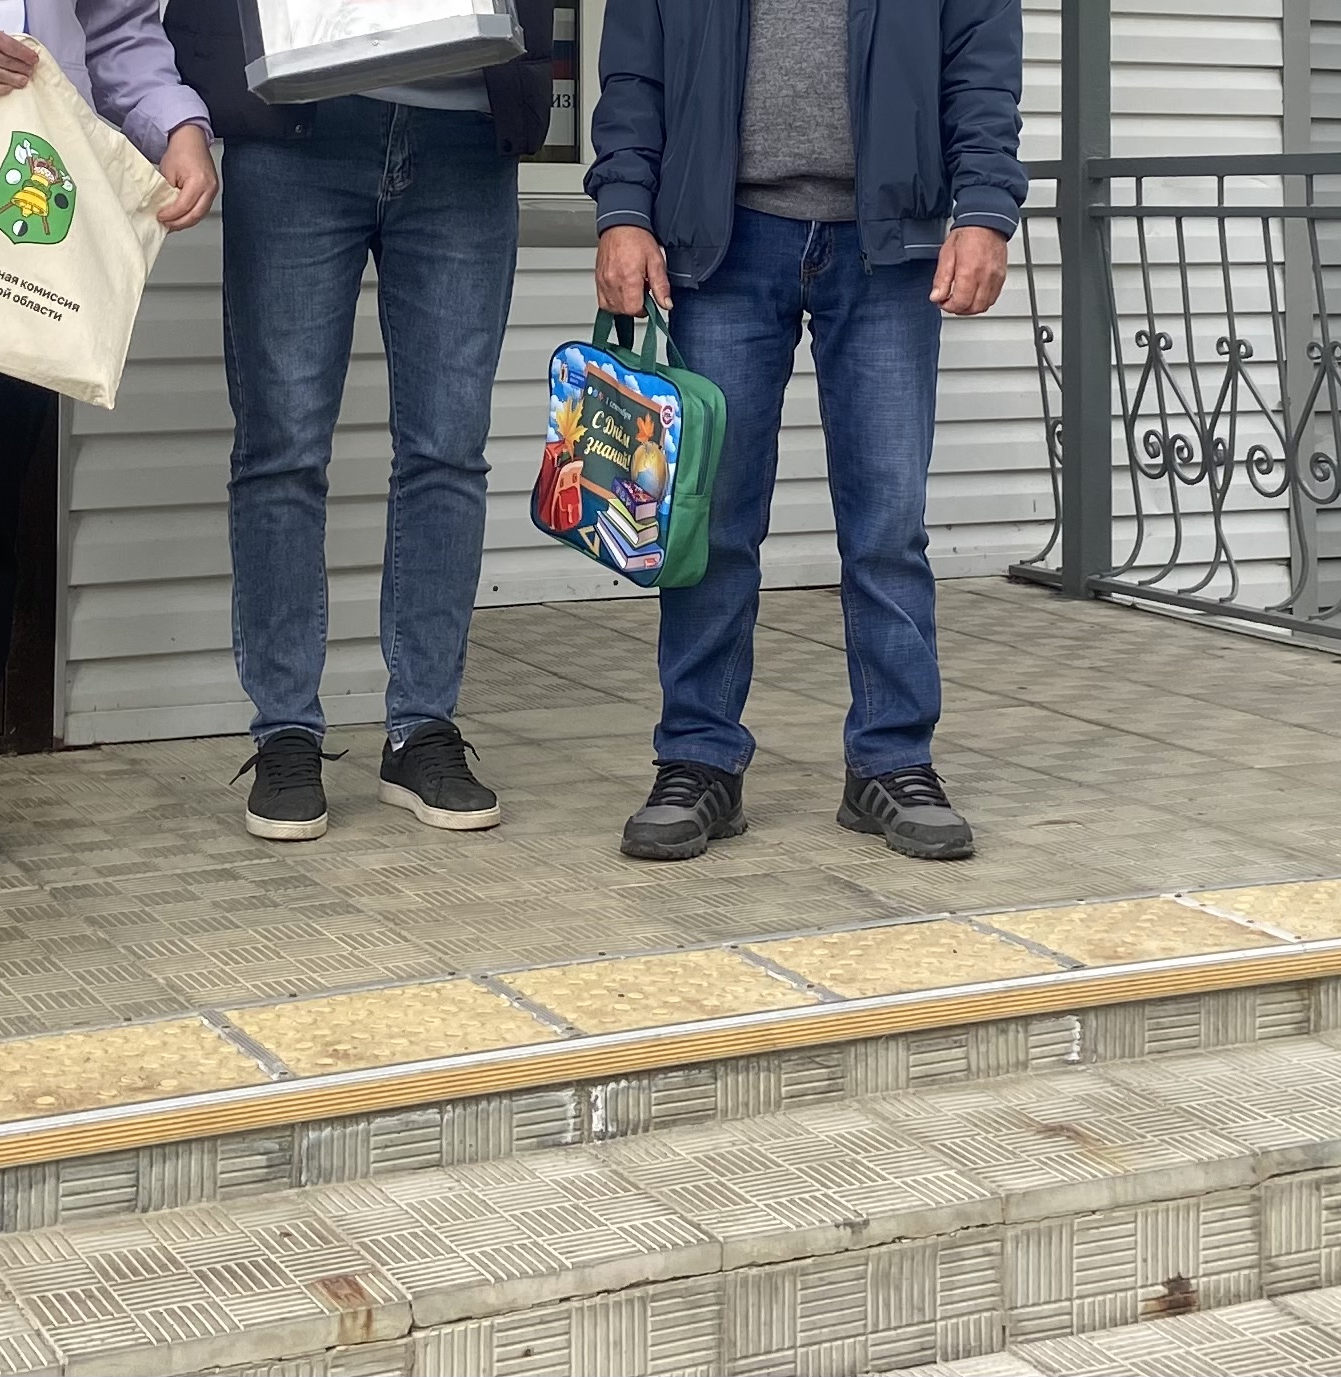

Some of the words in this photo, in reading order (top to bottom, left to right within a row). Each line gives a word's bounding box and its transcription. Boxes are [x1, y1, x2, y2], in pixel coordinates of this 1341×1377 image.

[12, 293, 63, 322] области
[20, 279, 80, 313] комиссия
[591, 410, 605, 429] С
